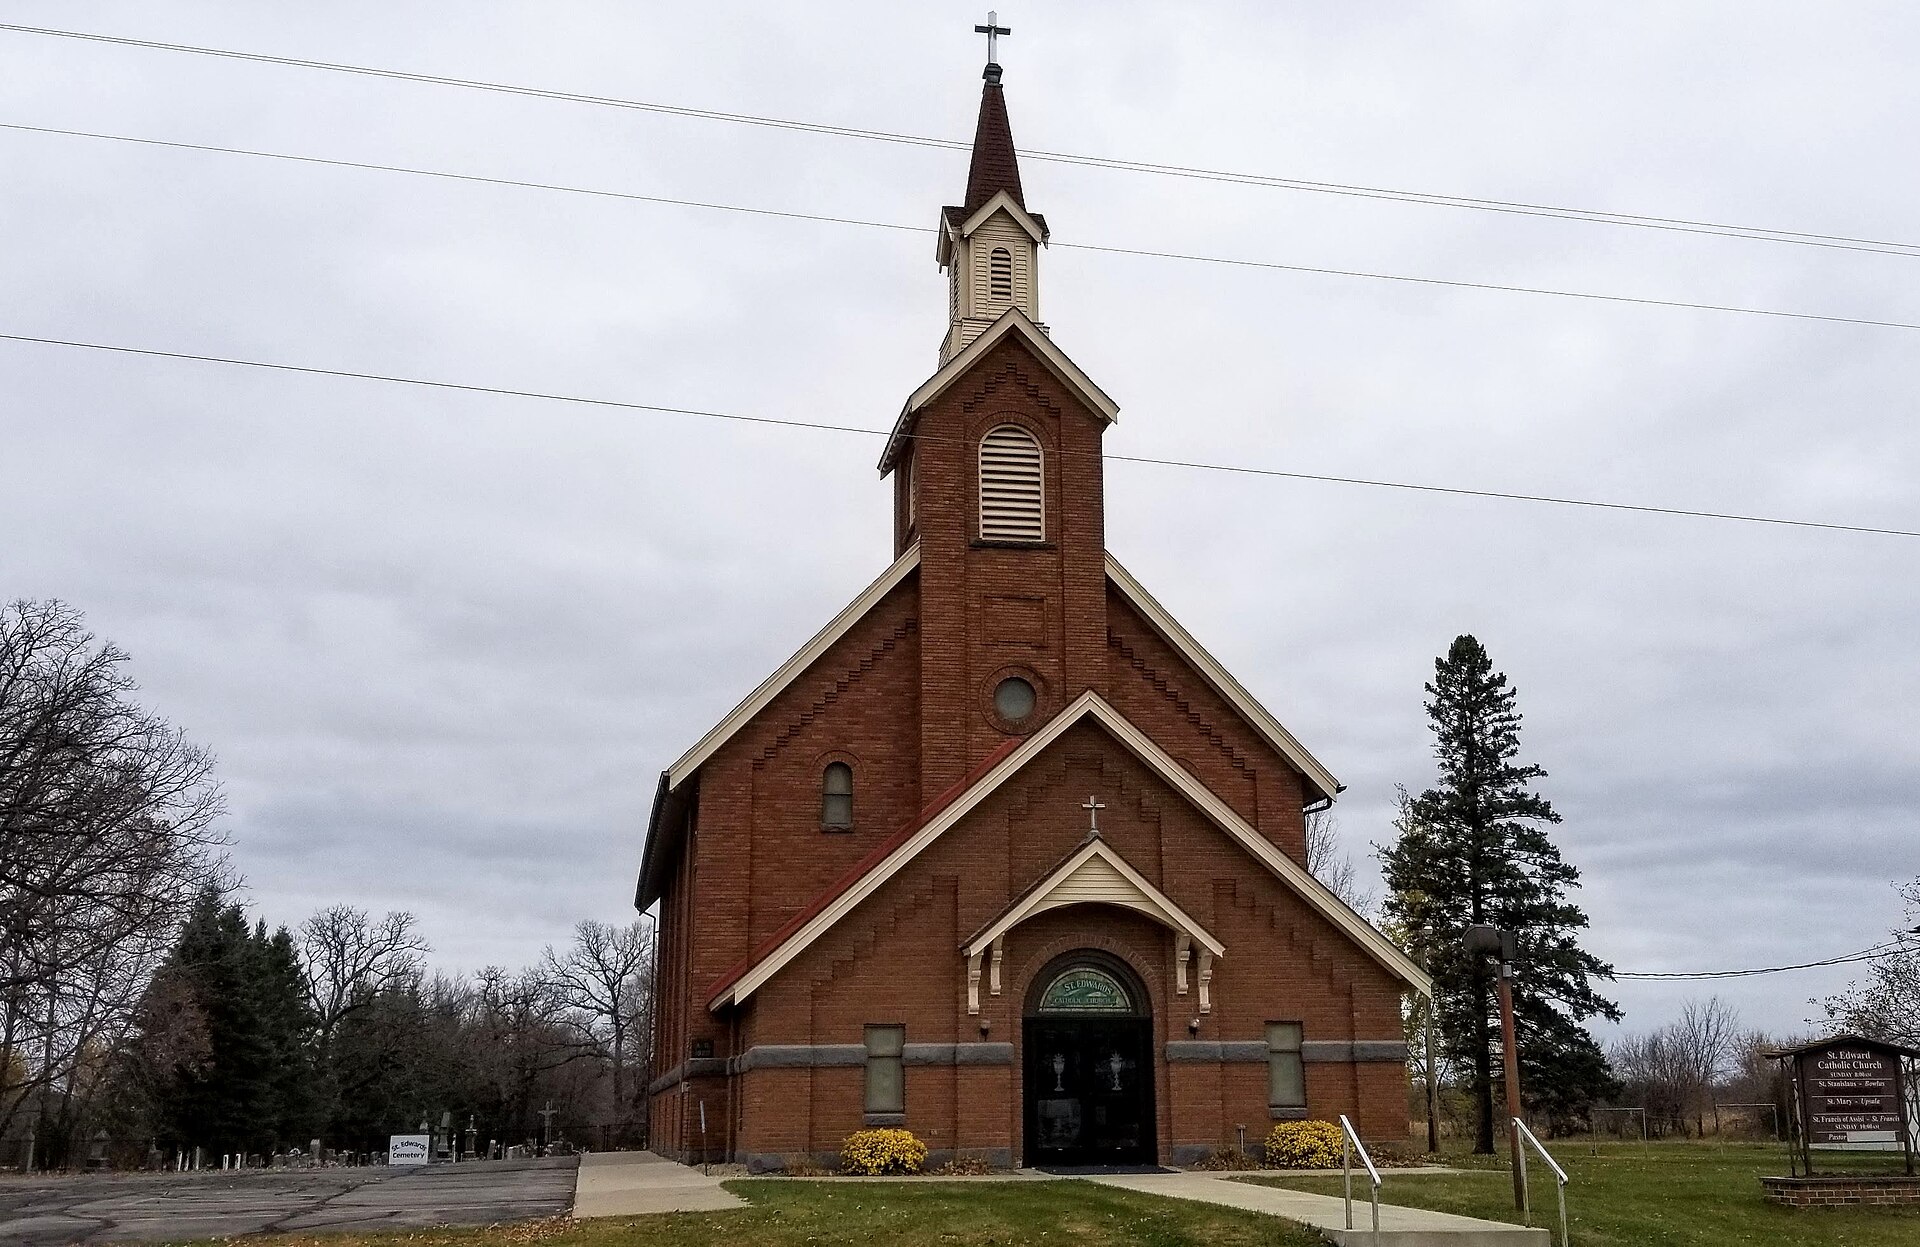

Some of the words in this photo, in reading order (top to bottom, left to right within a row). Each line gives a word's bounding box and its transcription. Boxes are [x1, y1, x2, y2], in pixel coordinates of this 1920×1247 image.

[1827, 1051, 1838, 1060] St.
[1840, 1051, 1871, 1060] Edward
[1817, 1061, 1851, 1070] Catholic
[1852, 1061, 1882, 1070] Church
[1836, 1098, 1852, 1106] Mary
[1842, 1115, 1849, 1123] of
[1849, 1115, 1865, 1123] Assisi
[1828, 1133, 1847, 1141] Pastor
[400, 1140, 427, 1151] Edwards
